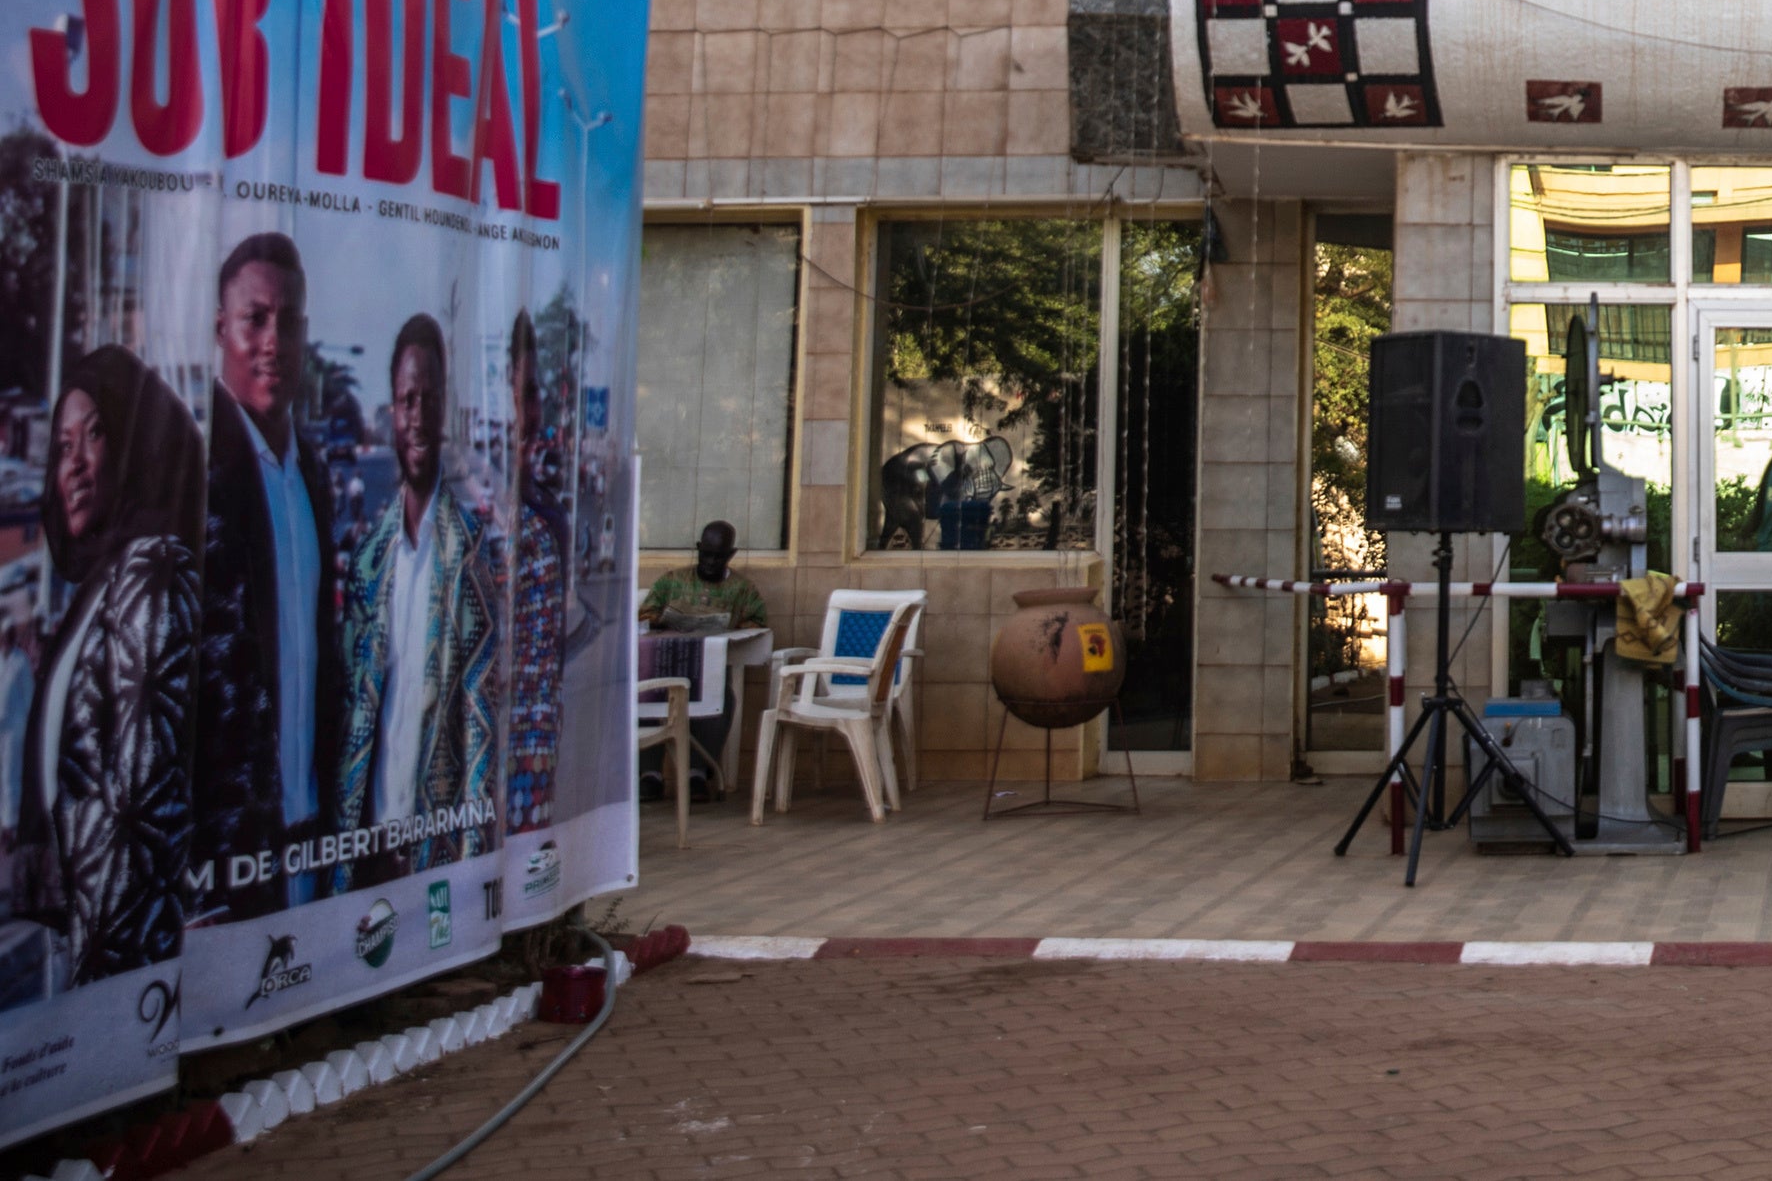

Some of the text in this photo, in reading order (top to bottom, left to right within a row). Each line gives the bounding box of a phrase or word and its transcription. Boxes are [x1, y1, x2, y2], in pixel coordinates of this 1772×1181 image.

[379, 200, 421, 222] GENTIL
[228, 849, 273, 888] DE
[285, 824, 382, 875] GILBERT
[386, 797, 497, 850] BARARMNA
[261, 966, 310, 996] ORCA
